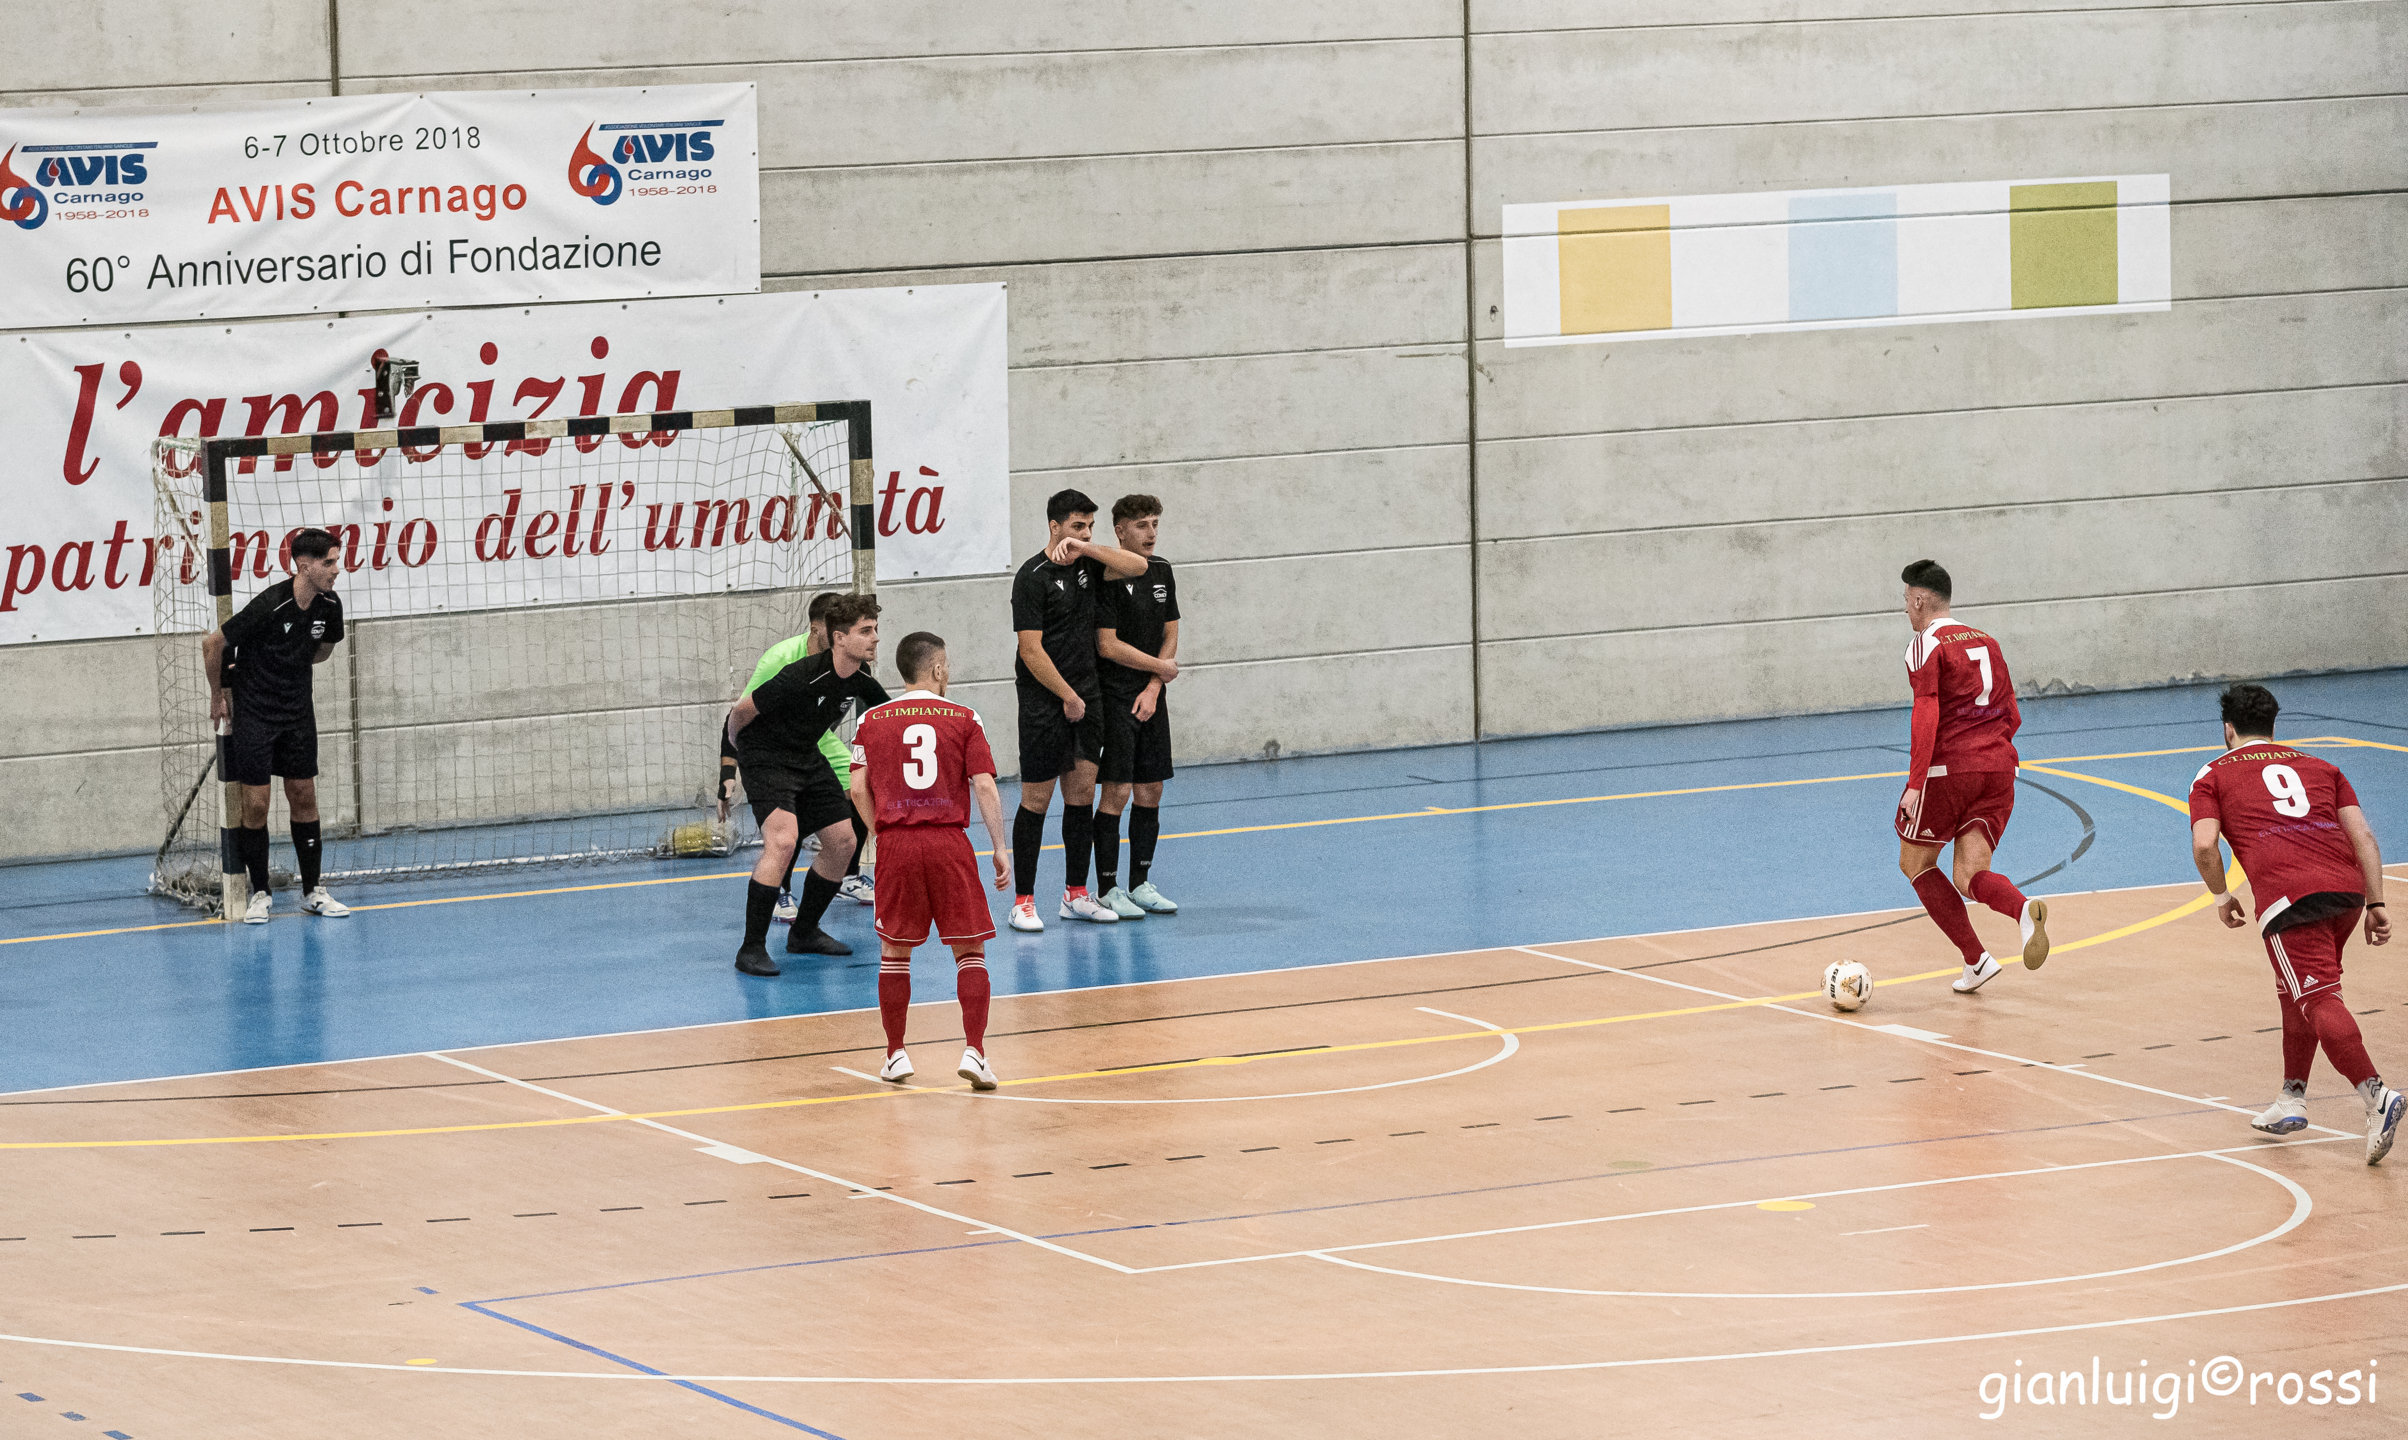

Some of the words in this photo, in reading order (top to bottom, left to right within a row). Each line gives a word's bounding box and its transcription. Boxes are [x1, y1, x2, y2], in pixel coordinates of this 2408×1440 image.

[244, 135, 288, 159] 6-7
[299, 131, 403, 156] Ottobre
[415, 126, 482, 151] 2018
[612, 130, 715, 165] AVIS
[35, 153, 148, 188] AVIS
[627, 168, 712, 181] Carnago
[53, 192, 144, 205] Carnago
[207, 182, 317, 225] AVIS
[334, 179, 528, 222] Carnago
[628, 184, 718, 197] 1958-2018
[55, 208, 150, 221] 1958-2018
[66, 255, 131, 293] 60°
[147, 250, 387, 290] Anniversario
[400, 239, 433, 276] di
[449, 234, 662, 274] Fondazione
[474, 464, 946, 563] dell'umantà
[1965, 645, 1994, 706] 7
[902, 723, 939, 790] 3
[2261, 763, 2312, 818] 9
